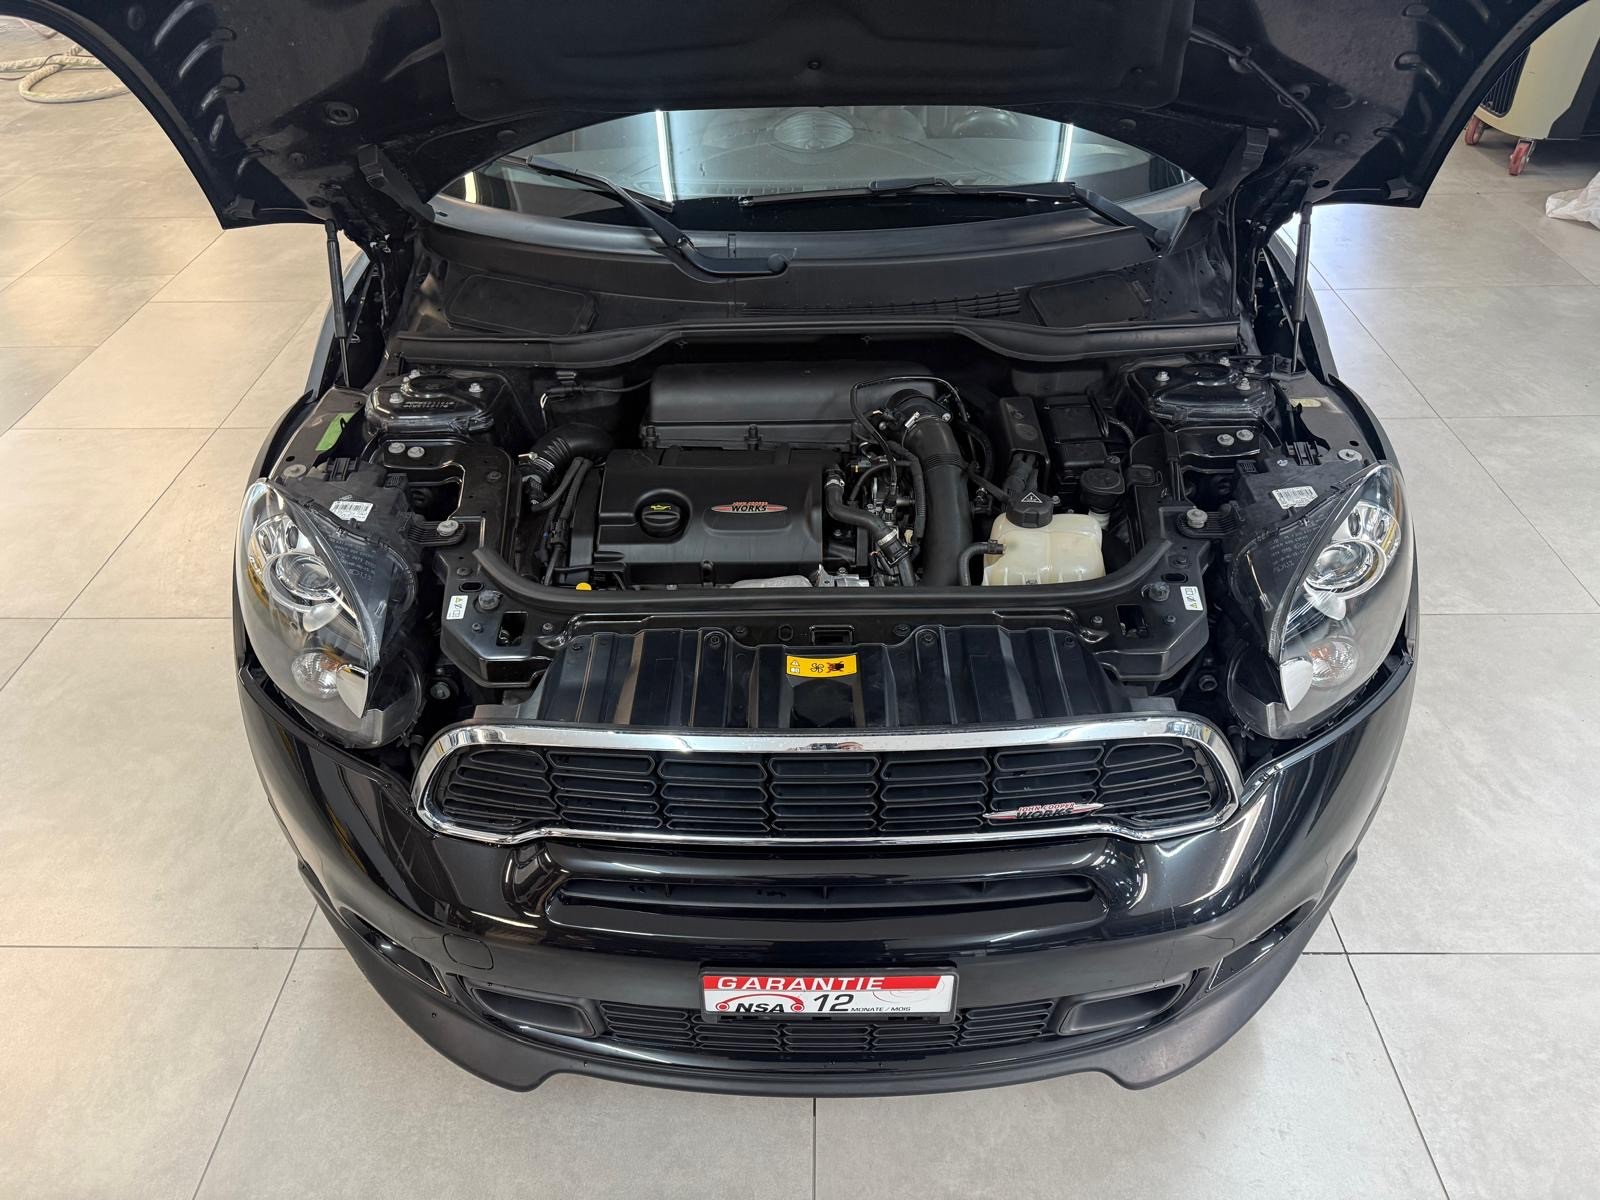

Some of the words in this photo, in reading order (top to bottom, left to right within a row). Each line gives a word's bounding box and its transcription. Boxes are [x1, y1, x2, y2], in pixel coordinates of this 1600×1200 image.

[717, 976, 886, 991] GARANTIE
[735, 1002, 785, 1013] NSA
[813, 993, 854, 1012] 12
